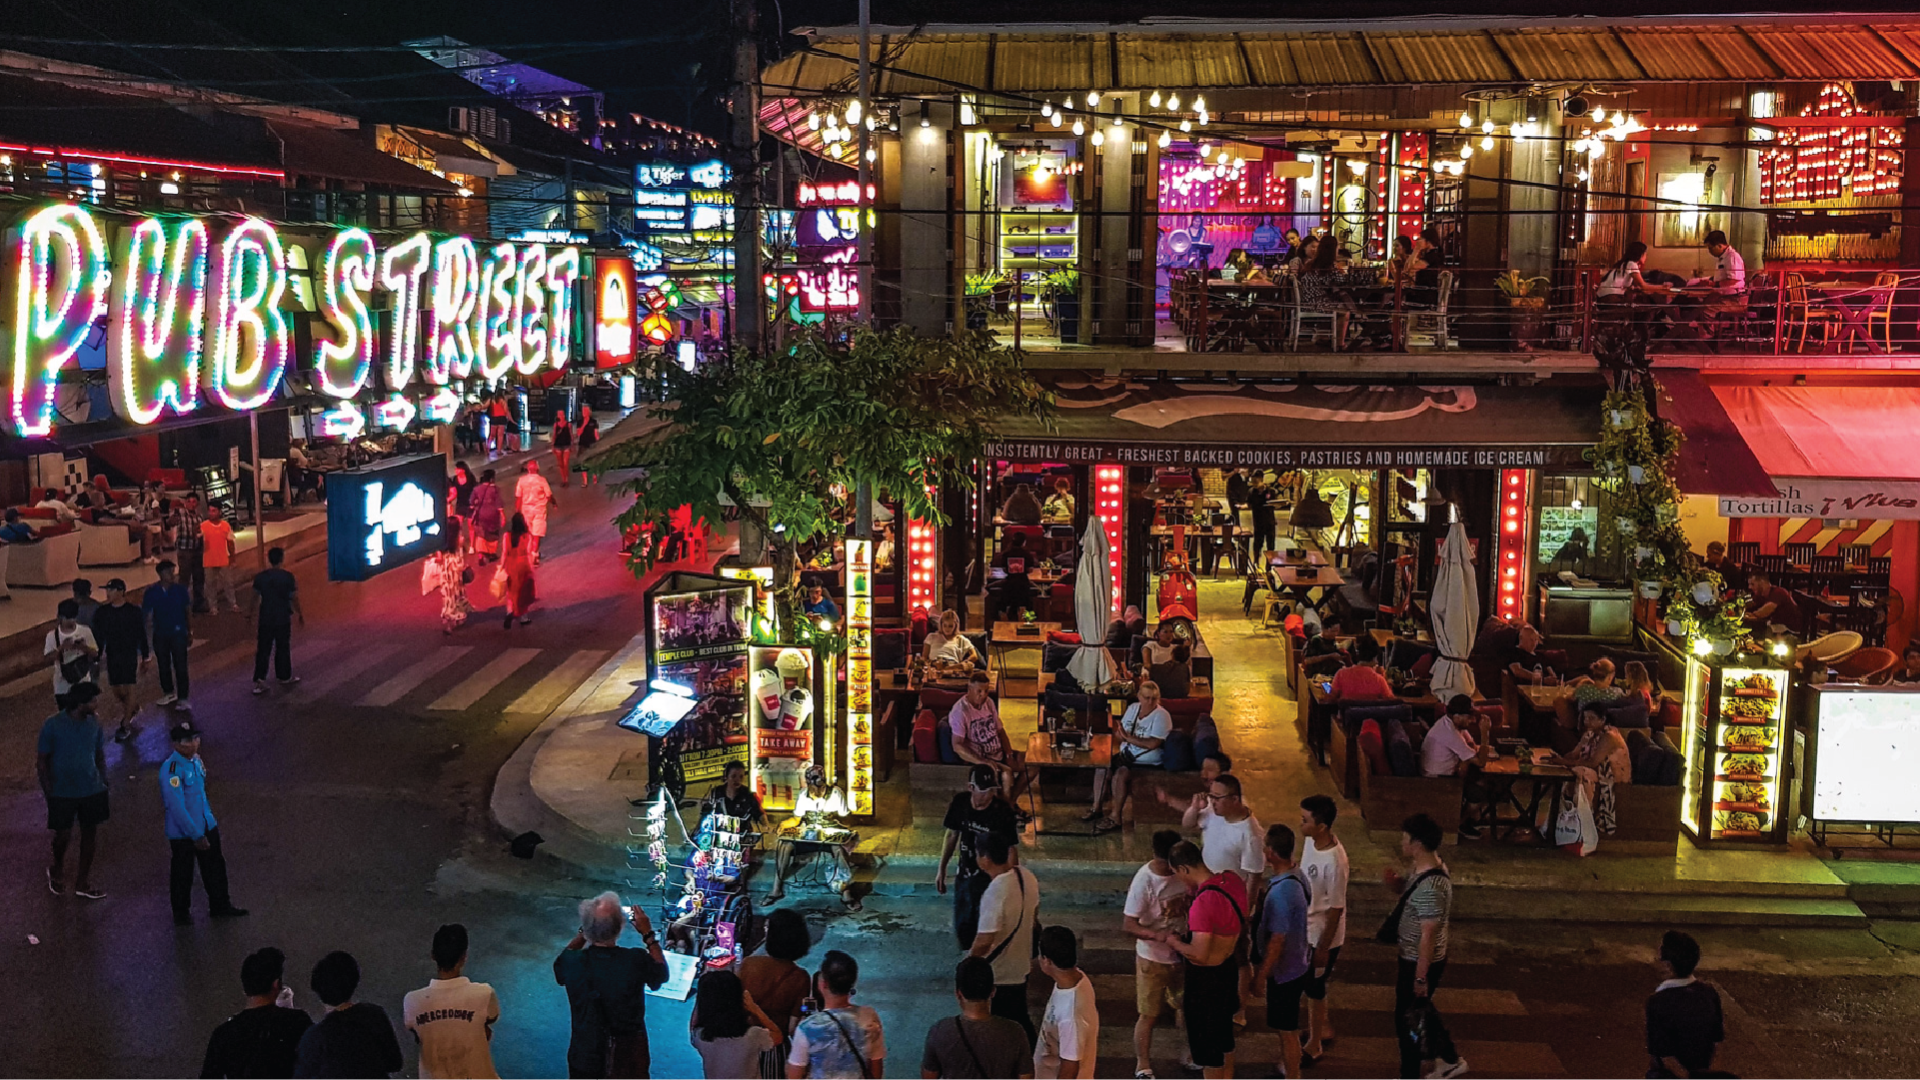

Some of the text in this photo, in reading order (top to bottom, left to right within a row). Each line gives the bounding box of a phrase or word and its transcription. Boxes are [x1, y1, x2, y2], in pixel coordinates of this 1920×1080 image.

[651, 166, 686, 185] Tiger
[10, 202, 582, 439] PUB STREET
[1064, 447, 1103, 460] GREAT
[1117, 448, 1178, 462] FRESHEST
[1184, 449, 1232, 463] BACKED
[1237, 450, 1296, 465] COOKIES,
[1300, 450, 1361, 464] PASTRIES
[1366, 450, 1392, 464] AND
[1397, 450, 1469, 464] HOMEMADE
[1474, 450, 1495, 464] ICE
[1499, 450, 1544, 464] CREAM
[1721, 499, 1814, 514] Tortillas
[680, 649, 695, 657] CLUB
[699, 647, 713, 655] BEST
[759, 737, 806, 748] TAKE AWAY
